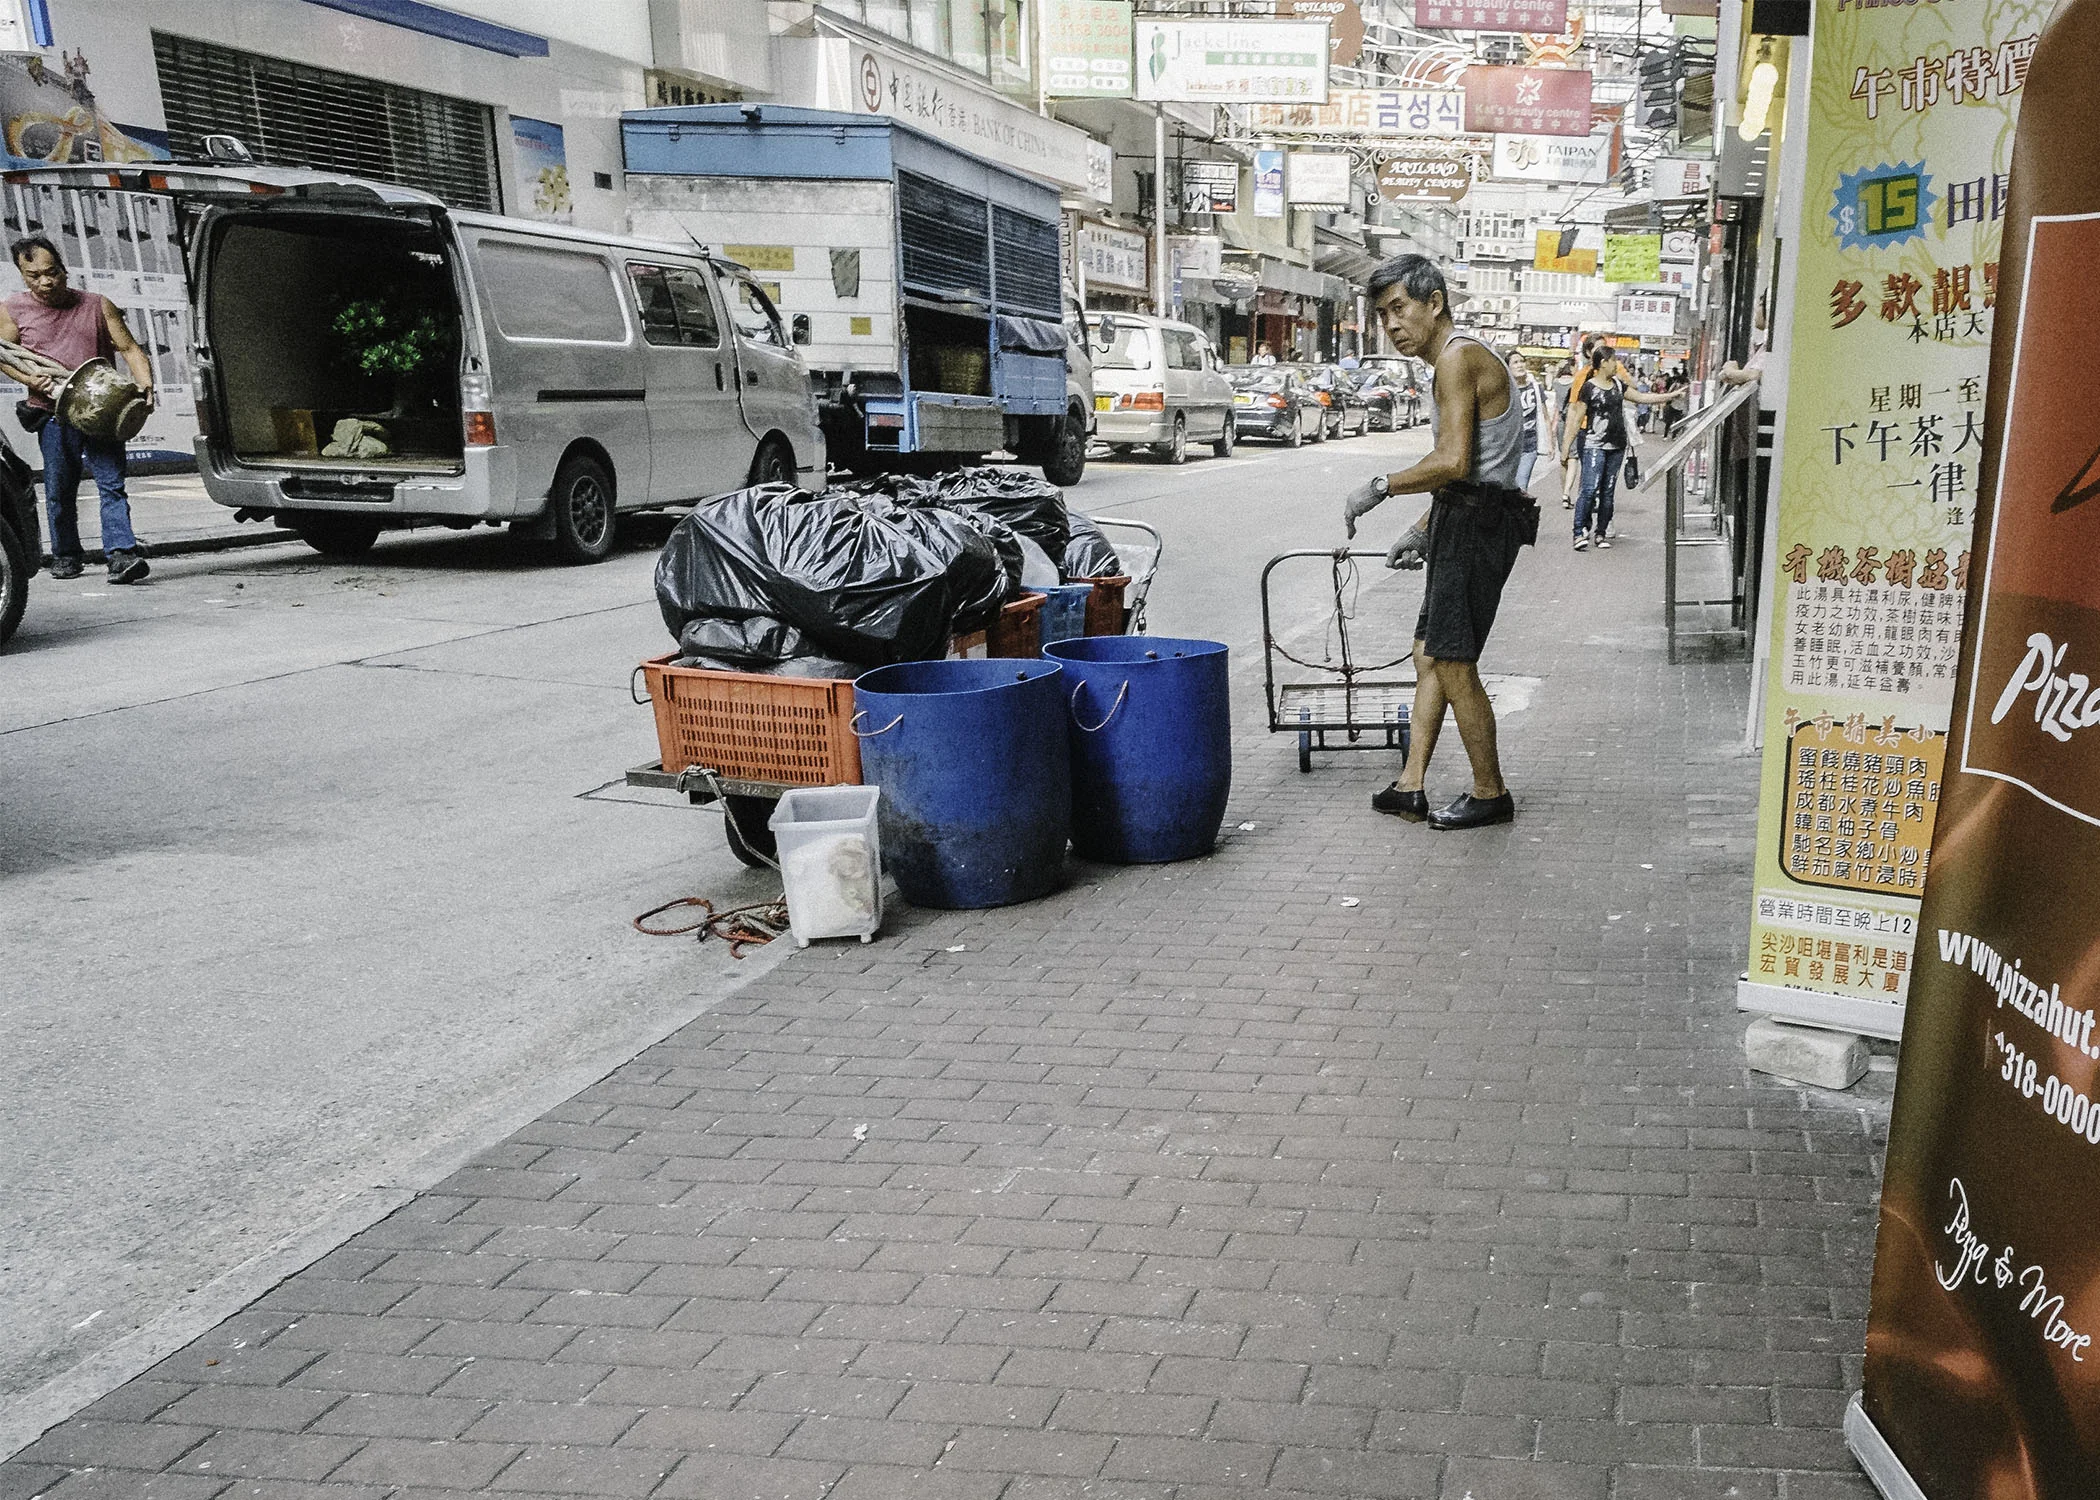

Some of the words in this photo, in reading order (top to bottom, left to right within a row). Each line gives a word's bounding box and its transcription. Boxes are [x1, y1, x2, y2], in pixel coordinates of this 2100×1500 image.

[1850, 33, 2040, 120] 午市特價
[974, 113, 1001, 146] BANK
[1003, 125, 1016, 146] OF
[1017, 133, 1047, 158] CHINA
[1547, 144, 1598, 157] TAIPAN
[1840, 173, 1919, 236] $15
[1907, 311, 1985, 344] 本店天
[1868, 375, 1981, 414] 星期一至
[1820, 411, 1986, 466] 下午茶大
[1886, 461, 1967, 503] 一律
[1784, 707, 1950, 749] 午市精美小
